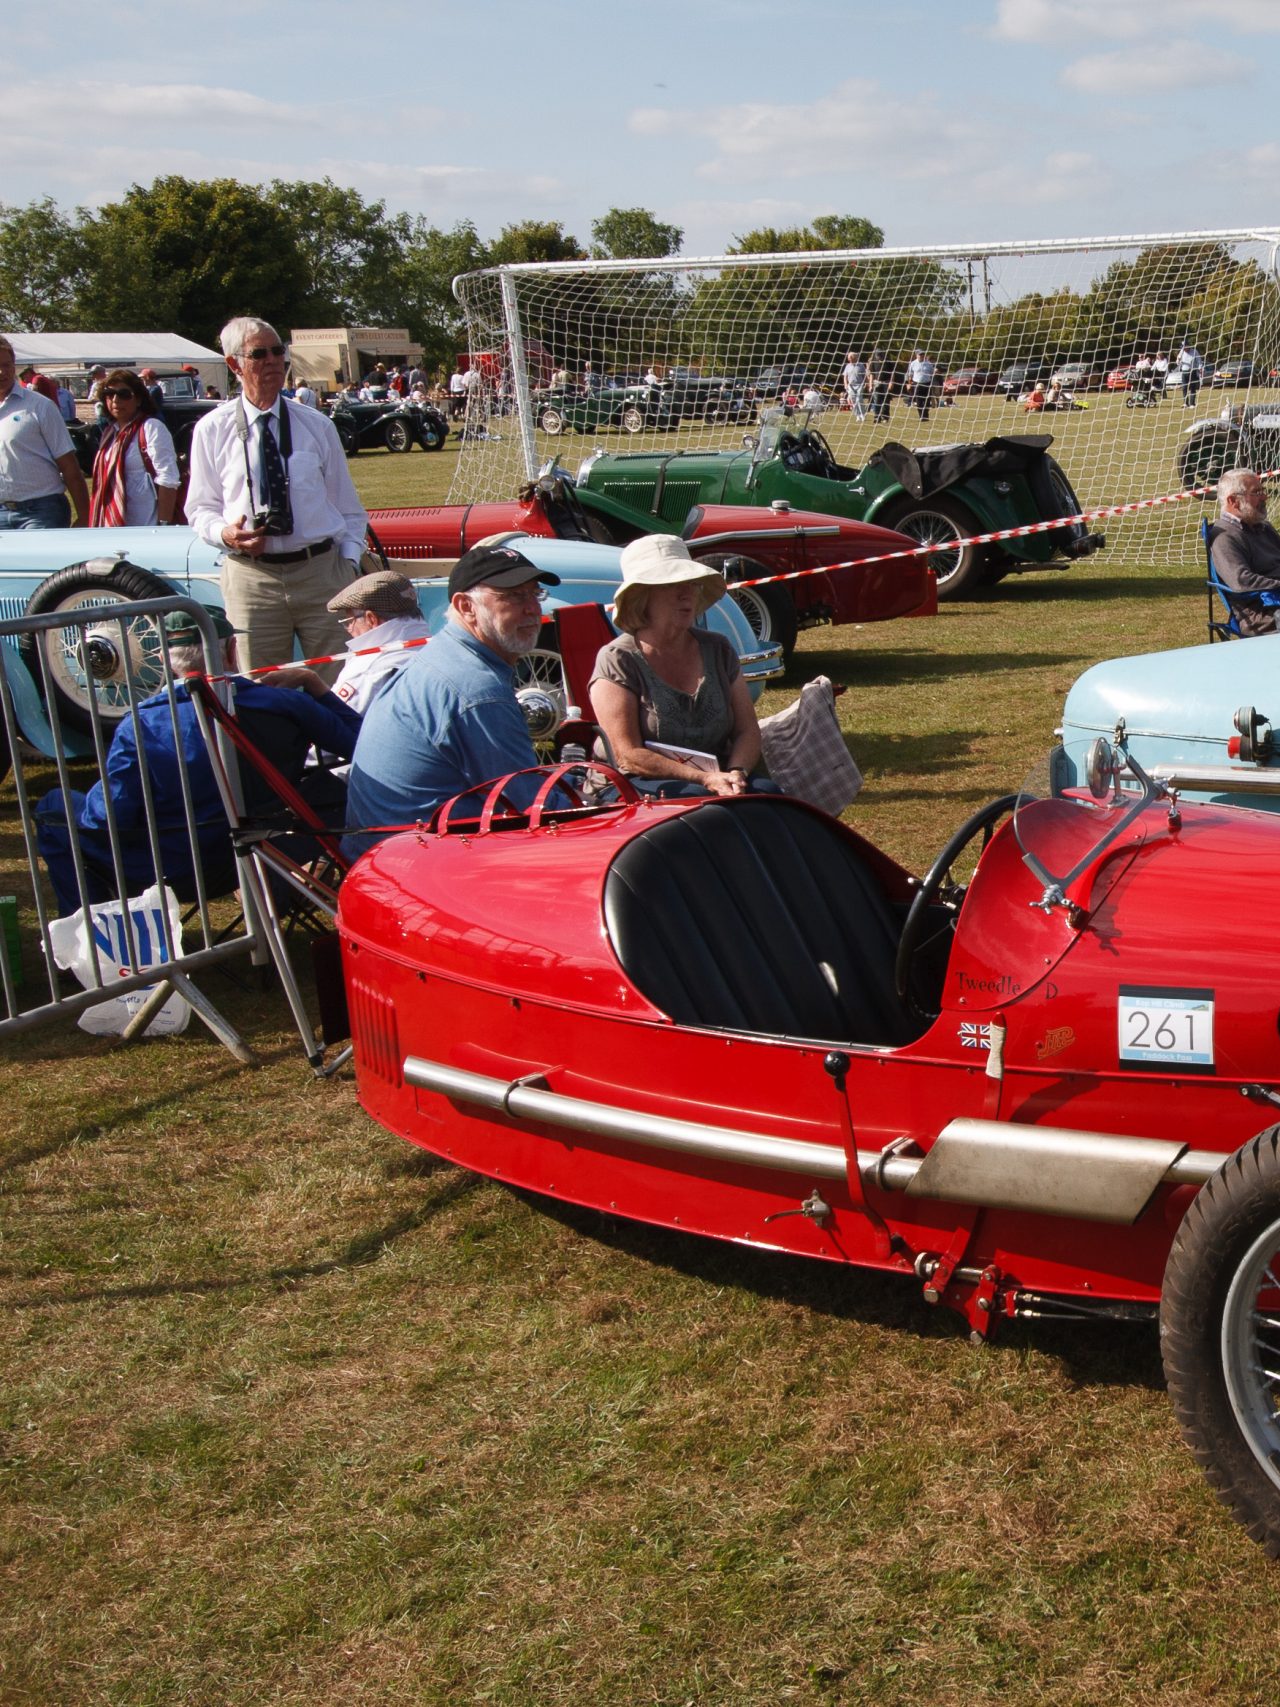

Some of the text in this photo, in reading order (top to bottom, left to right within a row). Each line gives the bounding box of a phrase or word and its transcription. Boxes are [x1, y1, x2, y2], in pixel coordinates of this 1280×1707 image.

[956, 971, 1059, 1000] Tweedle D
[1128, 1011, 1194, 1050] 261
